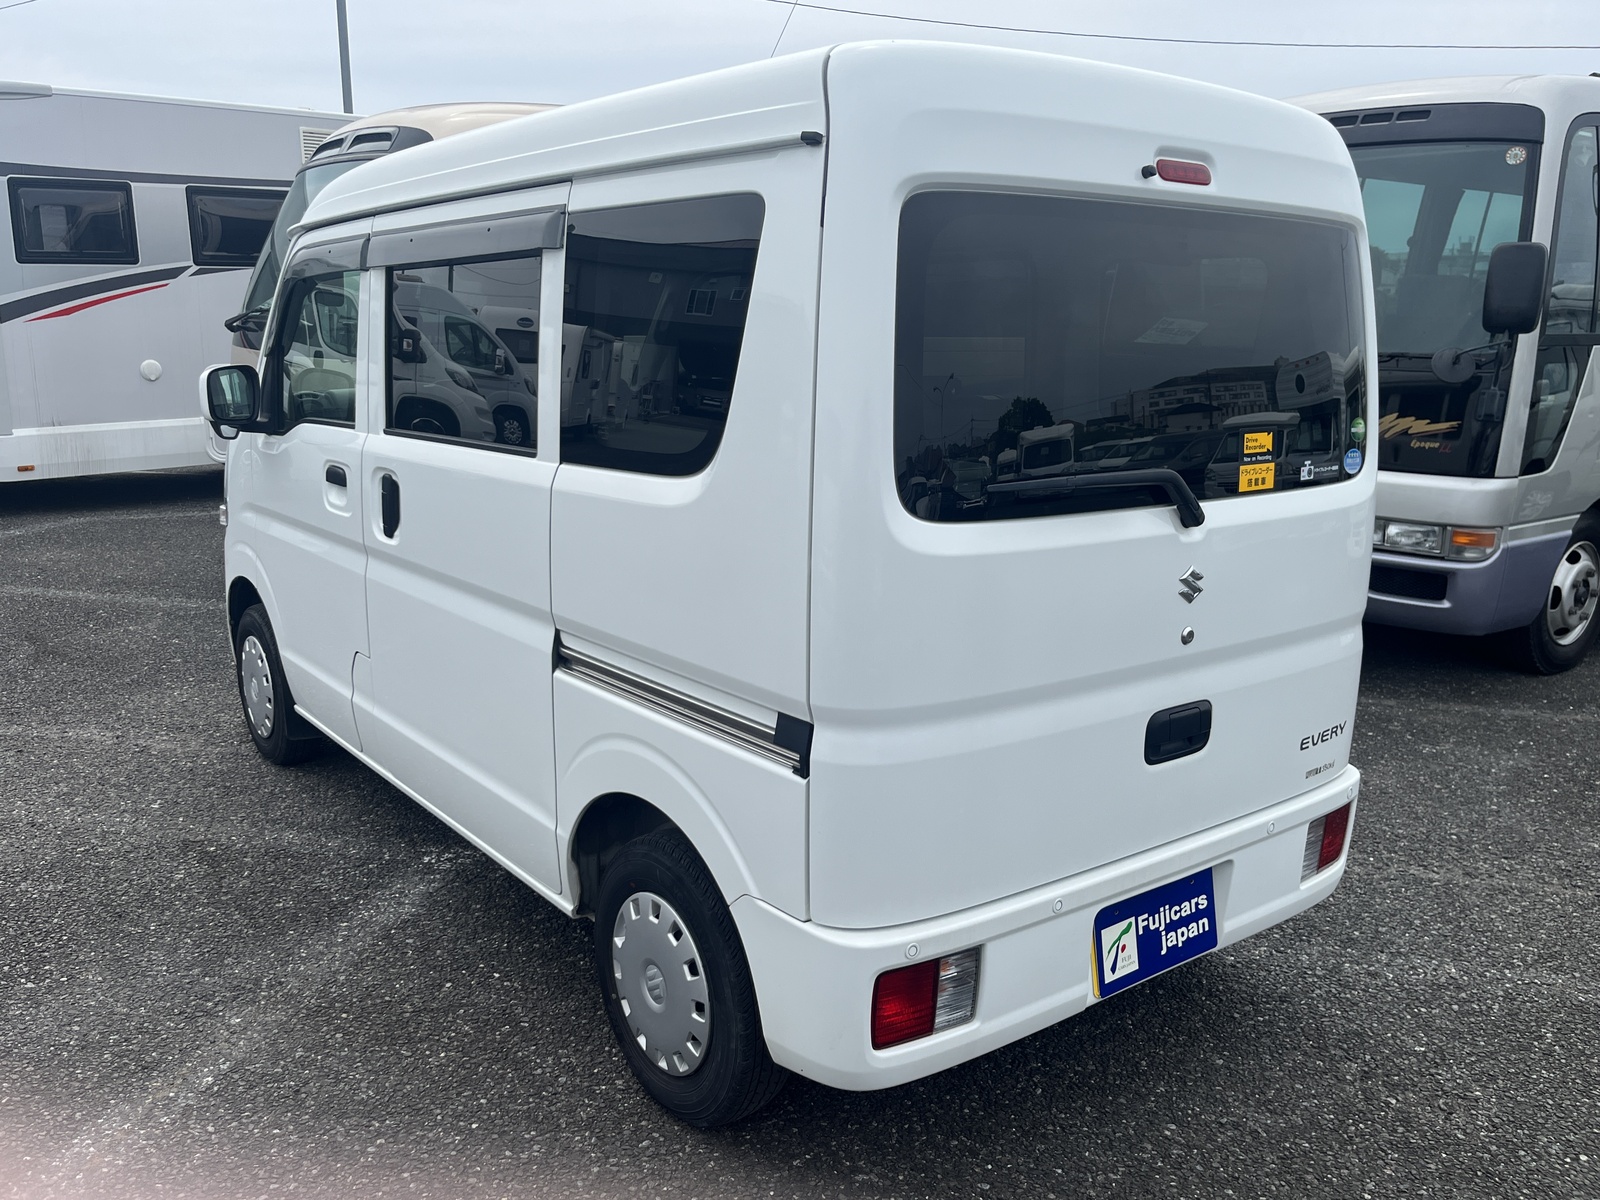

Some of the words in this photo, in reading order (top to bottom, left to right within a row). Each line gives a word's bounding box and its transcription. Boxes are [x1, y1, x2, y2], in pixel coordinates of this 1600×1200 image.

[1300, 720, 1347, 751] EVERY
[1137, 894, 1208, 936] Fujicars
[1160, 917, 1210, 956] japan
